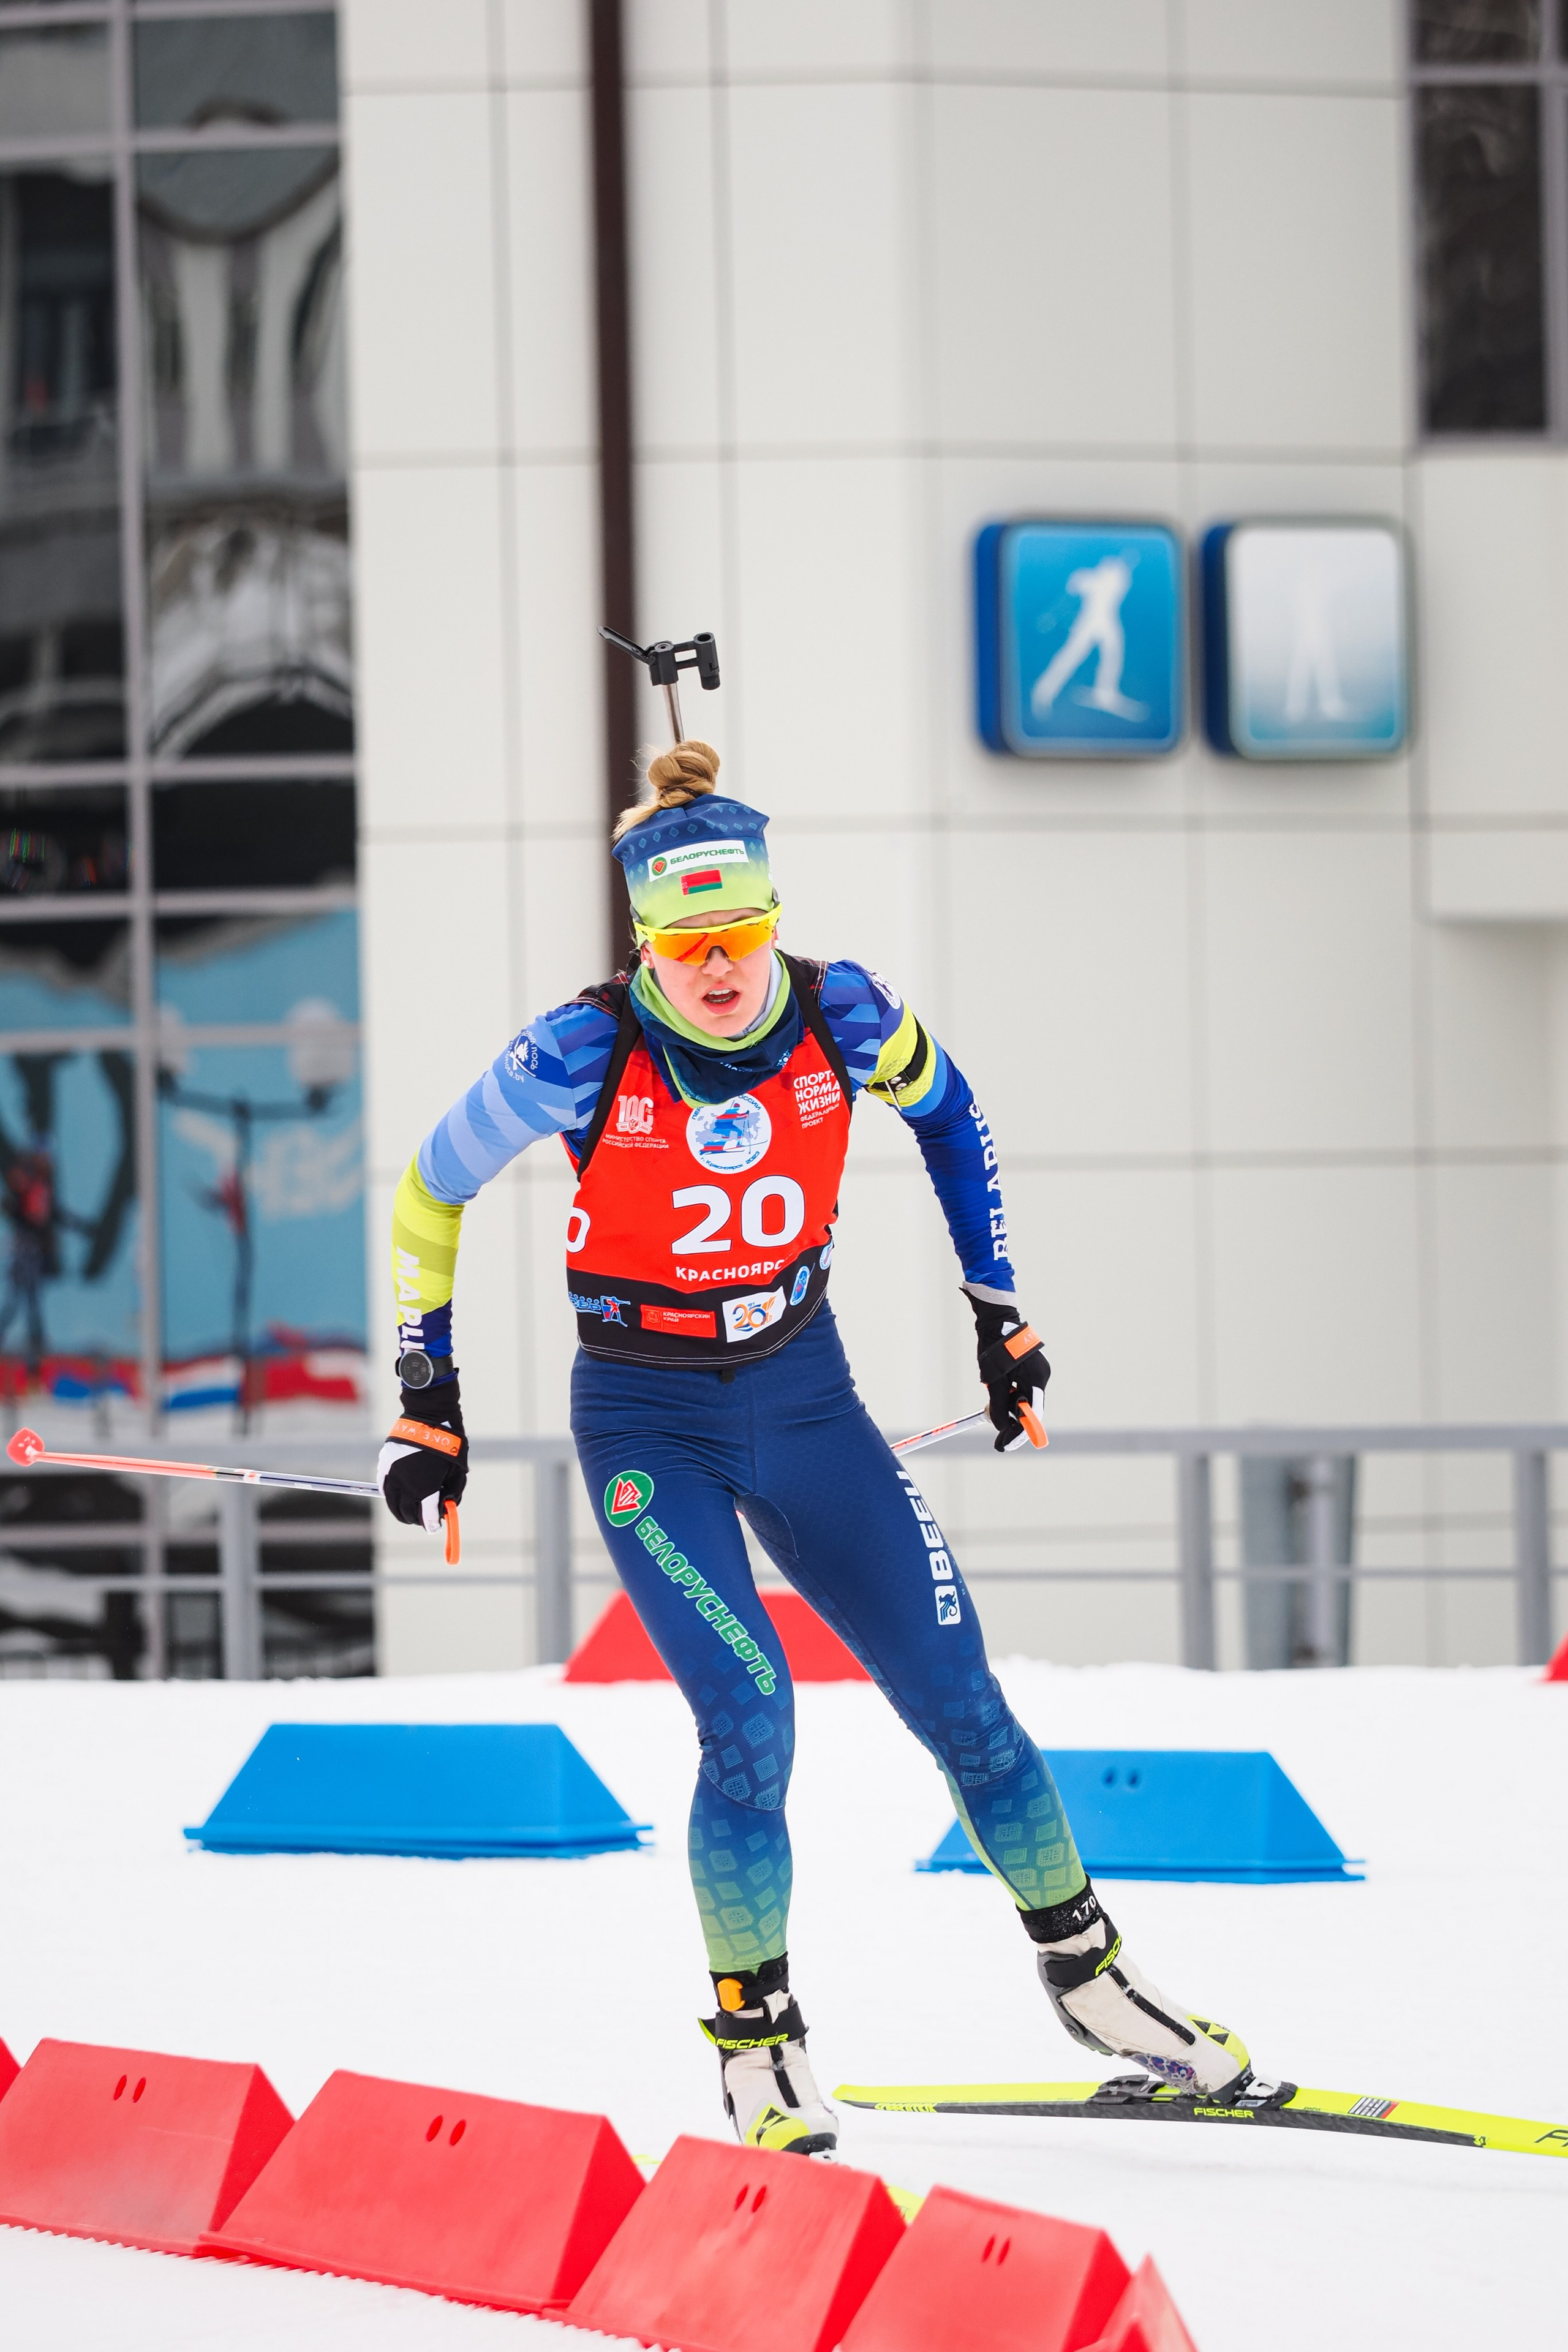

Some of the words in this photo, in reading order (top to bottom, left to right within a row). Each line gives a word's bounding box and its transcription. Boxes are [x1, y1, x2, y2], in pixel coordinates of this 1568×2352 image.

[670, 848, 745, 865] БЕЛОРУСНЕФТЬ
[793, 1069, 835, 1089] СПОРТ-
[795, 1080, 840, 1103] НОРМА
[797, 1091, 840, 1115] ЖИЗНИ
[801, 1117, 824, 1129] ПРОЕКТ
[602, 1138, 633, 1148] РОССИЙСКОЙ
[605, 1133, 644, 1142] МИНИСТЕРСТВО
[706, 1159, 744, 1170] Красноярск
[745, 1151, 760, 1164] 2023
[671, 1175, 806, 1254] 20
[676, 1257, 786, 1282] КРАСНОЯРС
[394, 1424, 416, 1436] WAY
[423, 1432, 450, 1446] ONE
[635, 1515, 777, 1696] БЕЛОРУСНЕФТЬ
[715, 2033, 789, 2049] FISCHER
[1194, 2107, 1255, 2119] FISCHER
